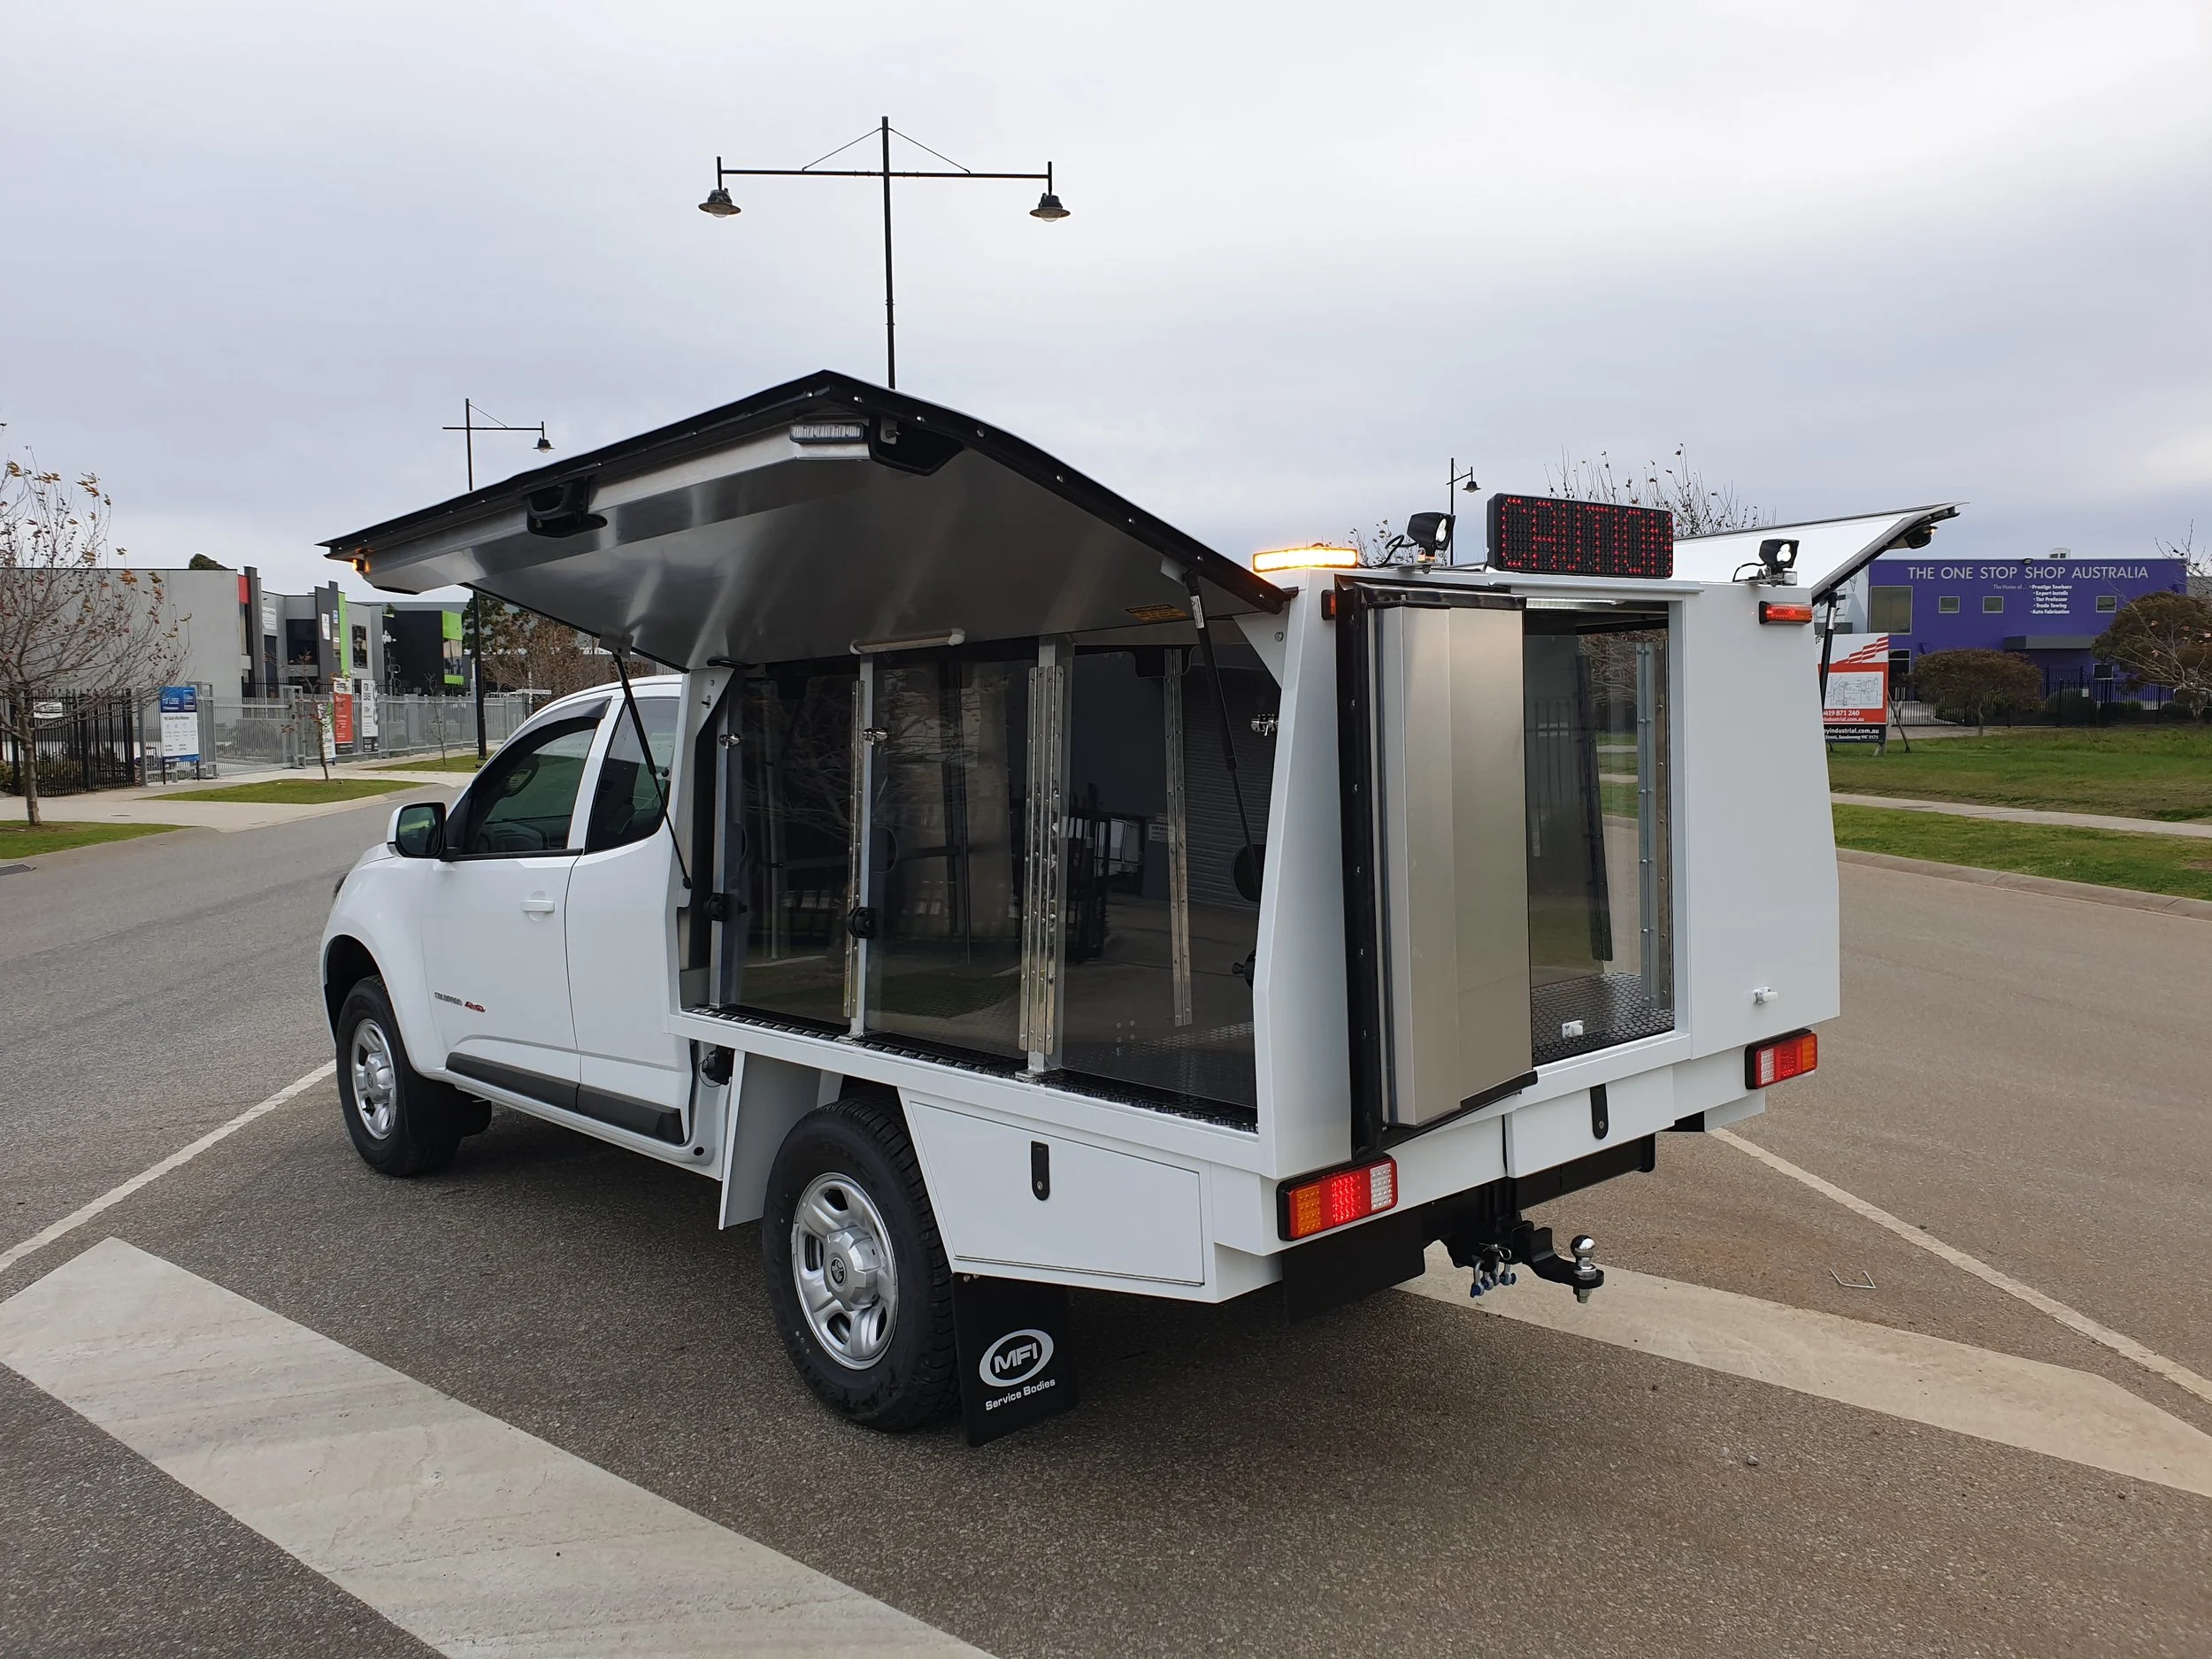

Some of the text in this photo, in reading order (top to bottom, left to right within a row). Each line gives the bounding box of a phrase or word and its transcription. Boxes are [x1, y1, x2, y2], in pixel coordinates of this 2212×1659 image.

[1502, 497, 1673, 574] CAUTION
[1908, 566, 2149, 580] THE ONE STOP SHOP AUSTRALIA
[994, 1342, 1038, 1373] MFI
[985, 1379, 1056, 1411] Service Bodies
